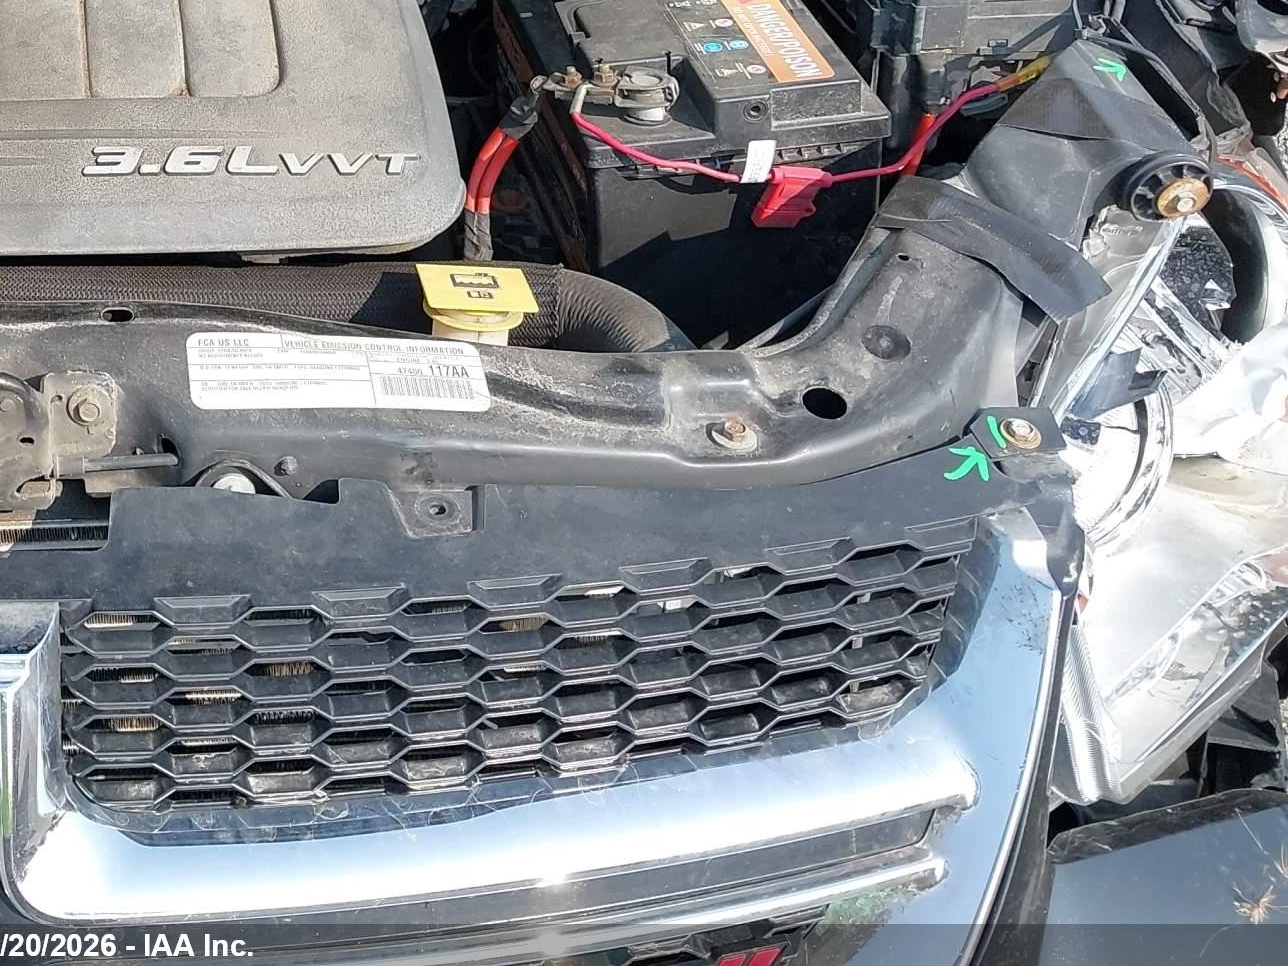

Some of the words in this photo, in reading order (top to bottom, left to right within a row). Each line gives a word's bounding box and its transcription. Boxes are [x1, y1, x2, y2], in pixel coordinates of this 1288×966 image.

[745, 3, 824, 78] DANGER/POISON
[198, 338, 215, 346] FCA
[218, 338, 230, 346] US
[233, 338, 249, 346] LLC
[284, 339, 319, 349] VEHICLE
[321, 341, 363, 350] EMISSION
[364, 343, 403, 353] CONTROL
[406, 345, 464, 354] INFORMATION
[429, 365, 470, 378] 117AA
